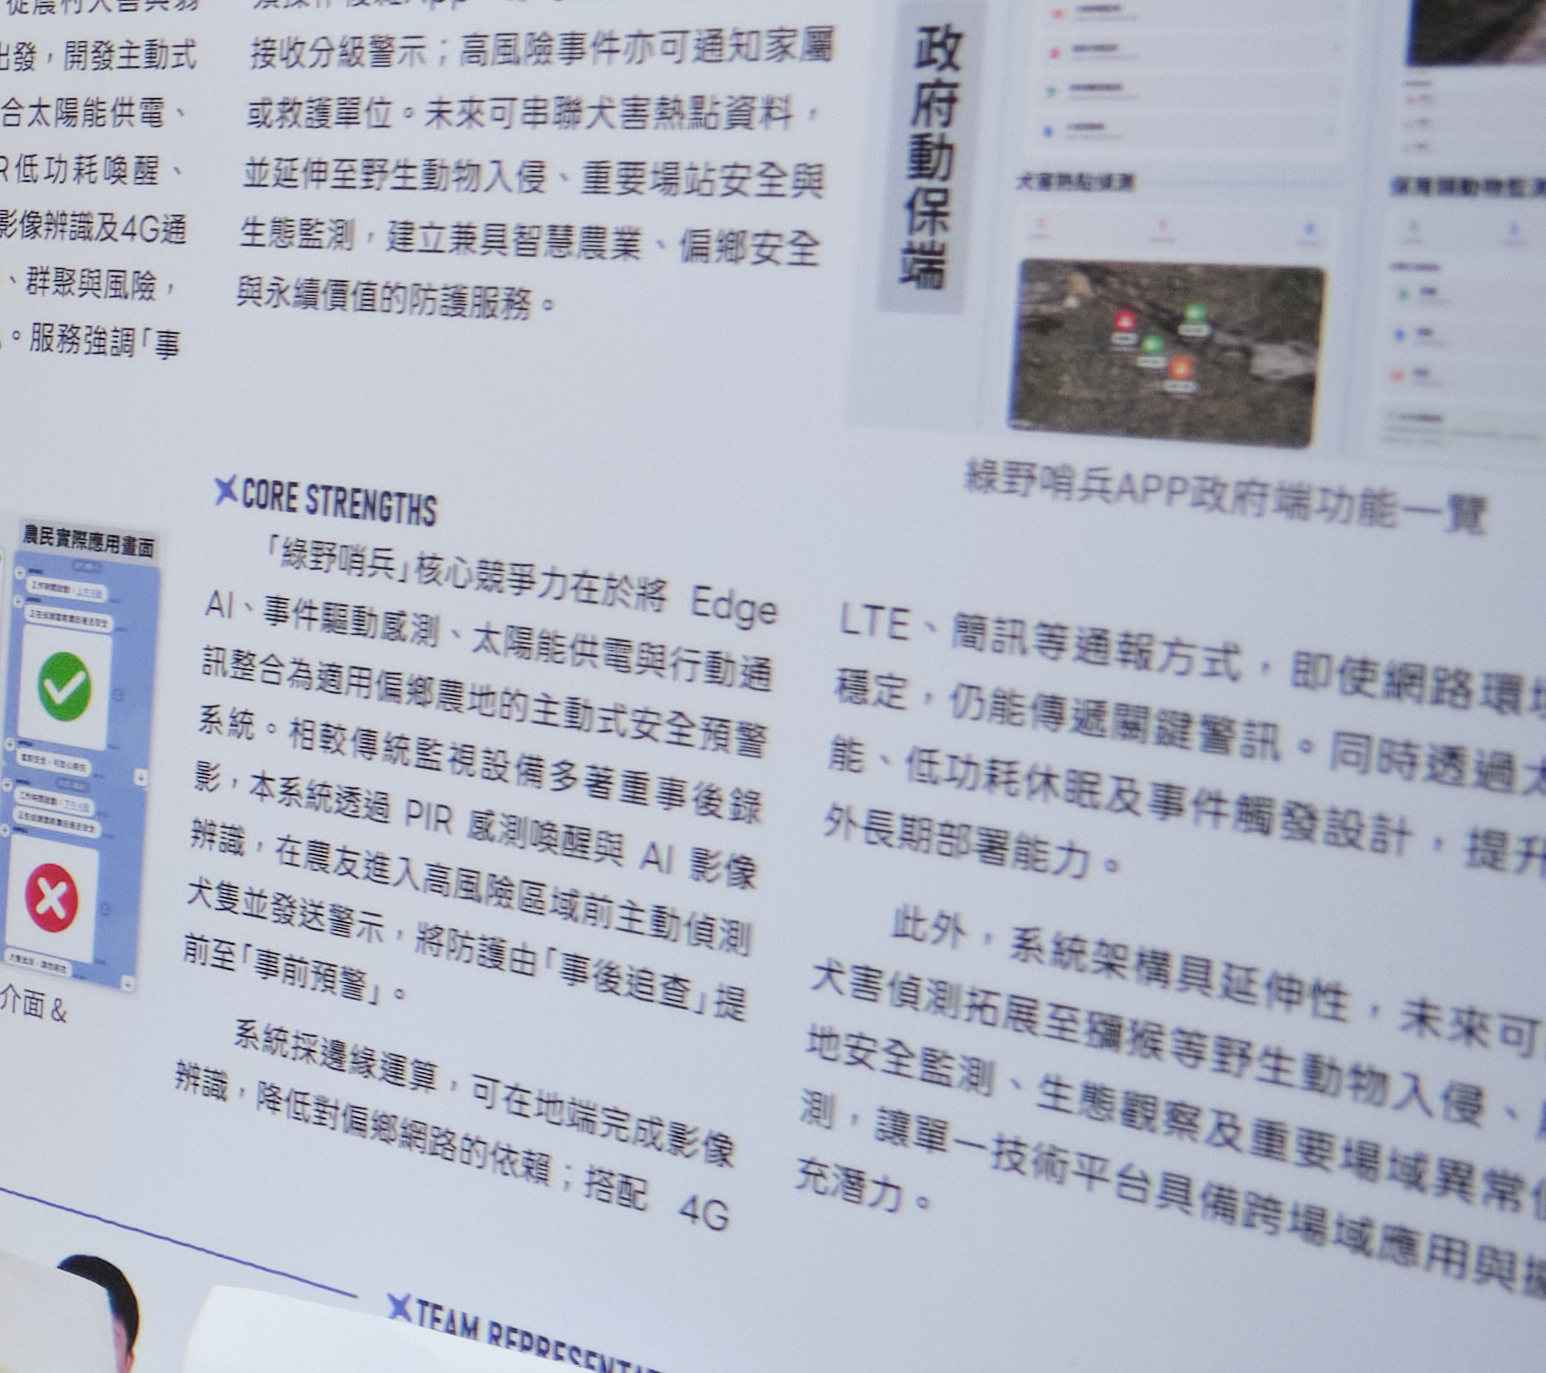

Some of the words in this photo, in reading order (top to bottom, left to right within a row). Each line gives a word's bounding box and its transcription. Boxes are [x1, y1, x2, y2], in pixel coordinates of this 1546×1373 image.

[898, 23, 965, 291] 政府動保端
[236, 274, 556, 322] 與永續價值的防護服務。
[242, 476, 298, 514] CORE
[306, 481, 438, 527] STRENGTHS
[964, 456, 1488, 536] 綠野哨兵APP政府端功能一覽
[23, 525, 155, 558] 農民實際應用畫面
[692, 585, 779, 629] Edge
[201, 645, 767, 759] 訊整合為適用偏鄉農地的主動式安全預警
[194, 760, 391, 825] 影，本系統透過
[405, 798, 454, 833] PIR
[467, 807, 625, 868] 感測喚醒與
[639, 840, 674, 873] AI
[688, 845, 759, 891] 影像
[823, 803, 1121, 880] 外長期部署能力。
[51, 998, 68, 1024] &
[811, 958, 1546, 1140] 犬害偵測拓展至獼猴等野生動物入侵、
[678, 1193, 730, 1231] 4G
[795, 1156, 931, 1214] 充潛力。
[416, 1298, 479, 1342] TEAM
